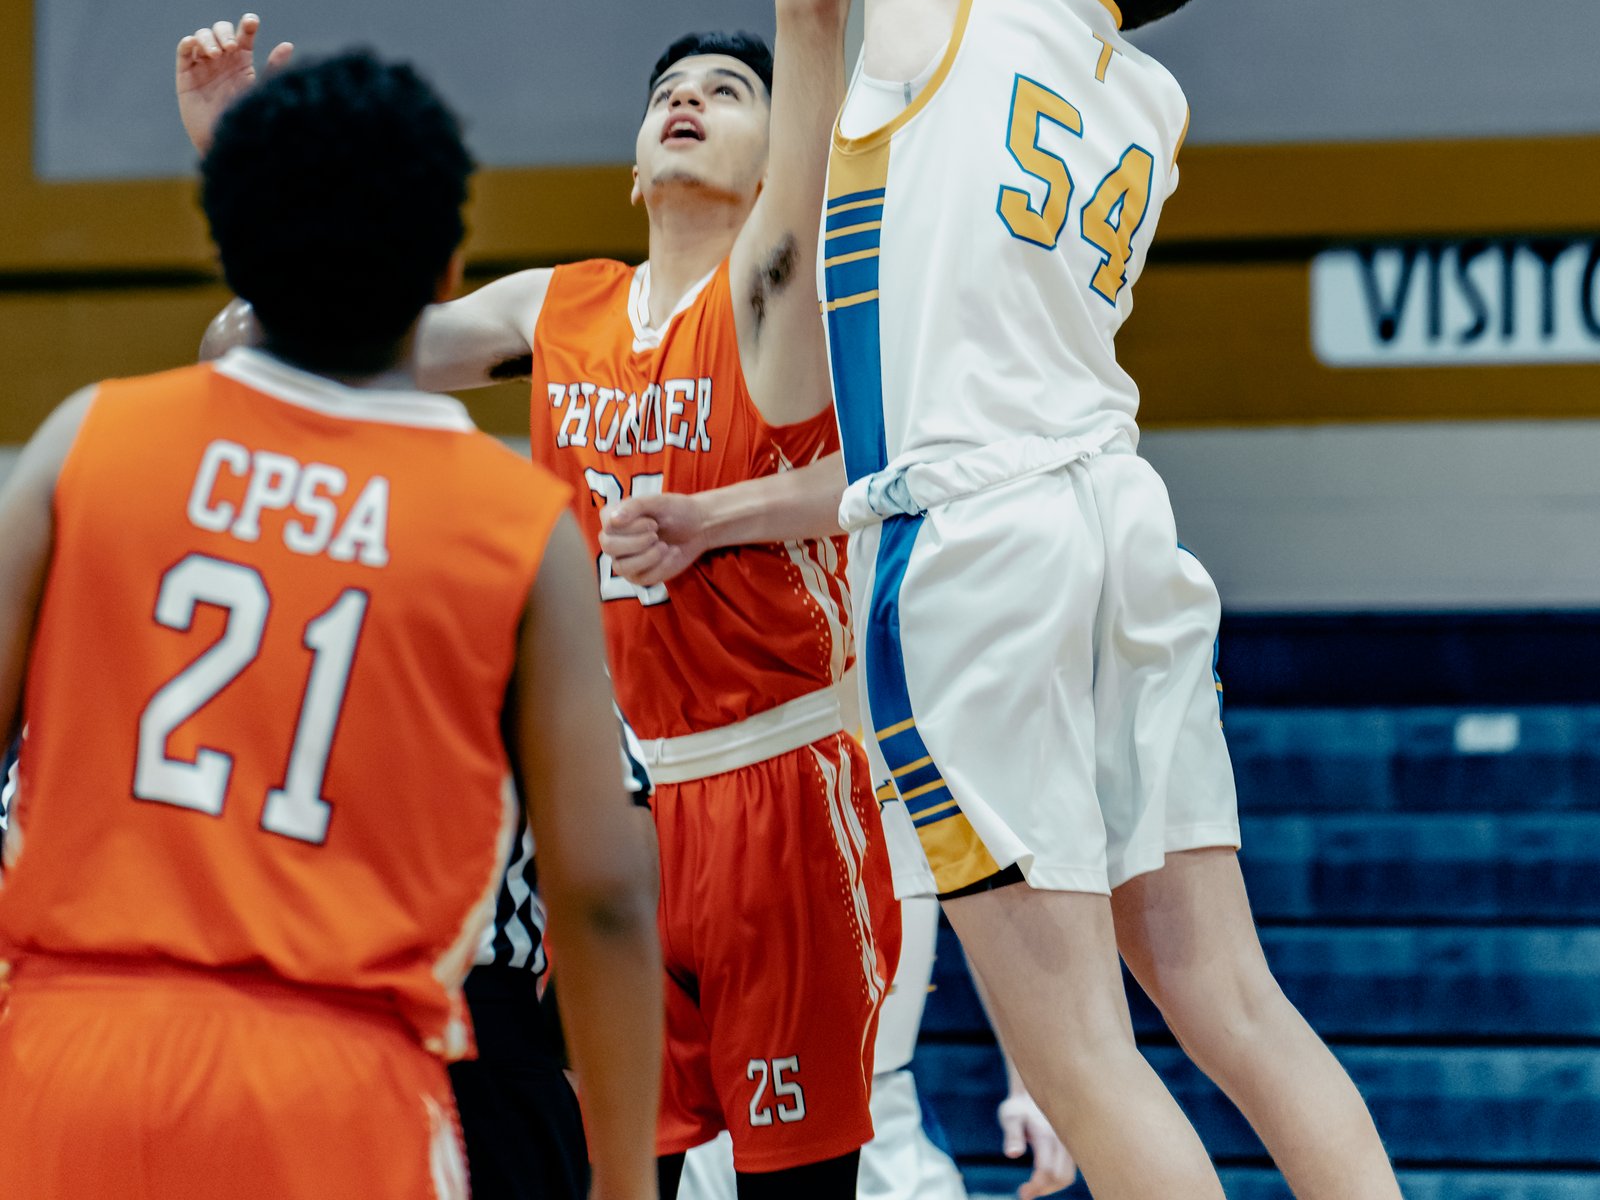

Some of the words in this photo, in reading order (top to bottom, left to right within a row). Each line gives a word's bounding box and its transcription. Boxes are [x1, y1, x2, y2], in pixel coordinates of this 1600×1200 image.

[995, 72, 1154, 308] 54
[186, 439, 390, 567] CPSA
[132, 551, 370, 846] 21
[746, 1055, 806, 1127] 25
